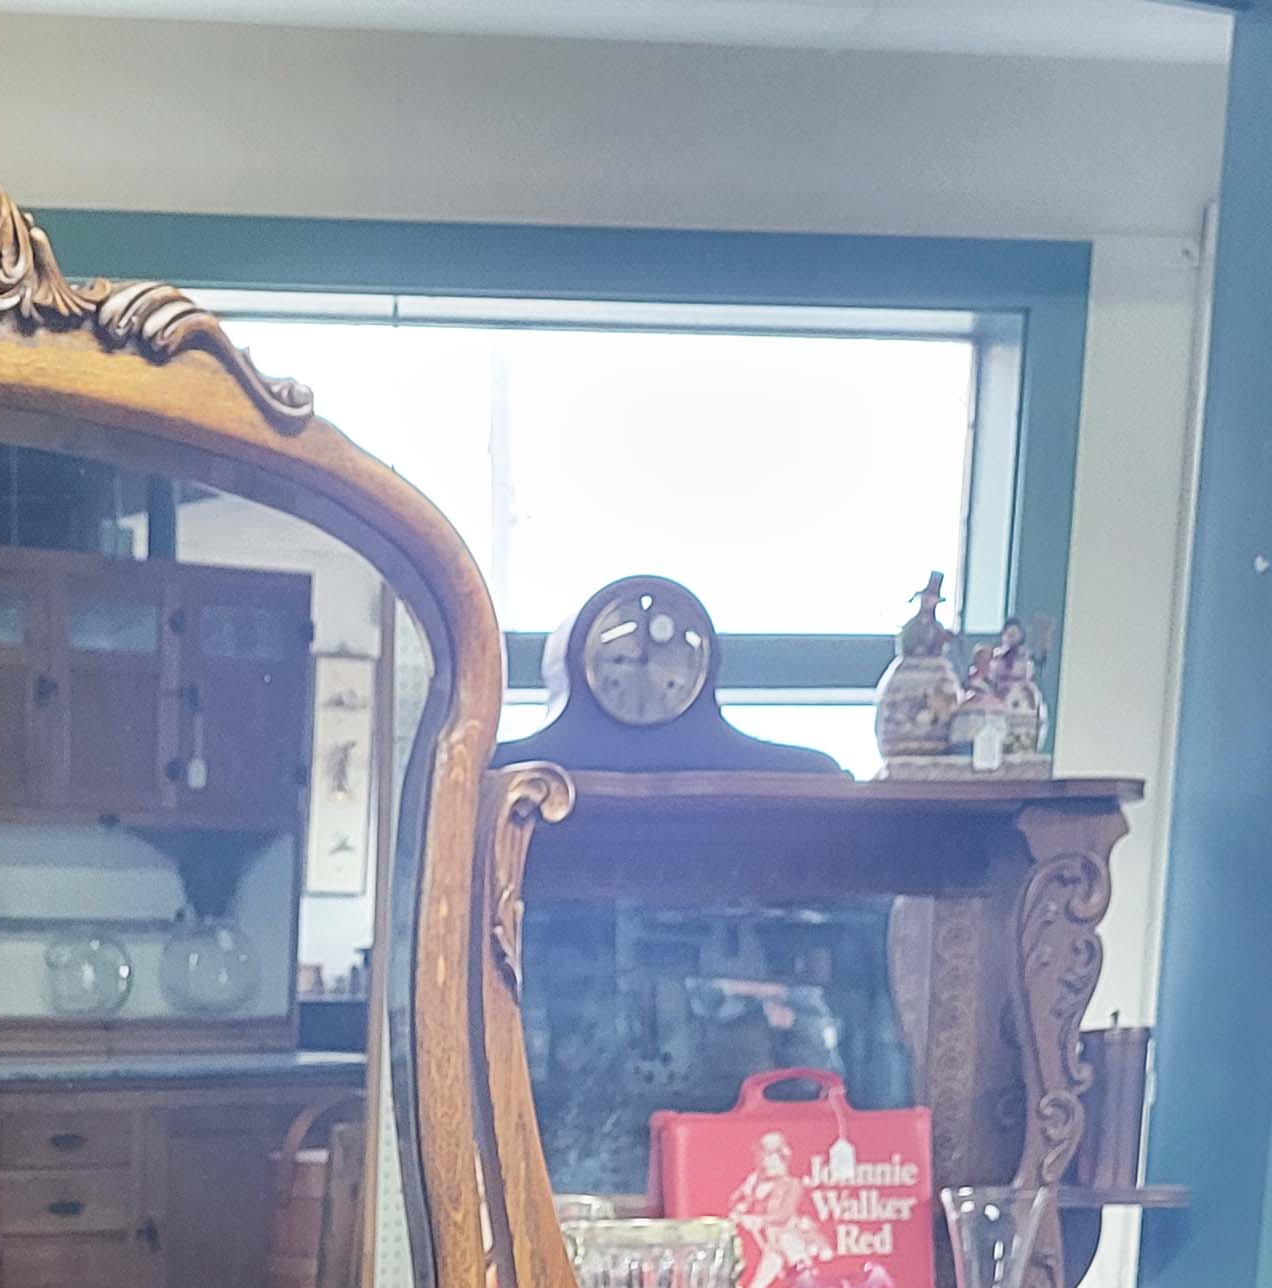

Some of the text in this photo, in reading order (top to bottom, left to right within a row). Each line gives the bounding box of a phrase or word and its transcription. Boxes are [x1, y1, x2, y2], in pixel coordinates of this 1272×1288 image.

[802, 1152, 919, 1187] Jonnie
[811, 1188, 916, 1221] Walker
[835, 1222, 893, 1256] Red
